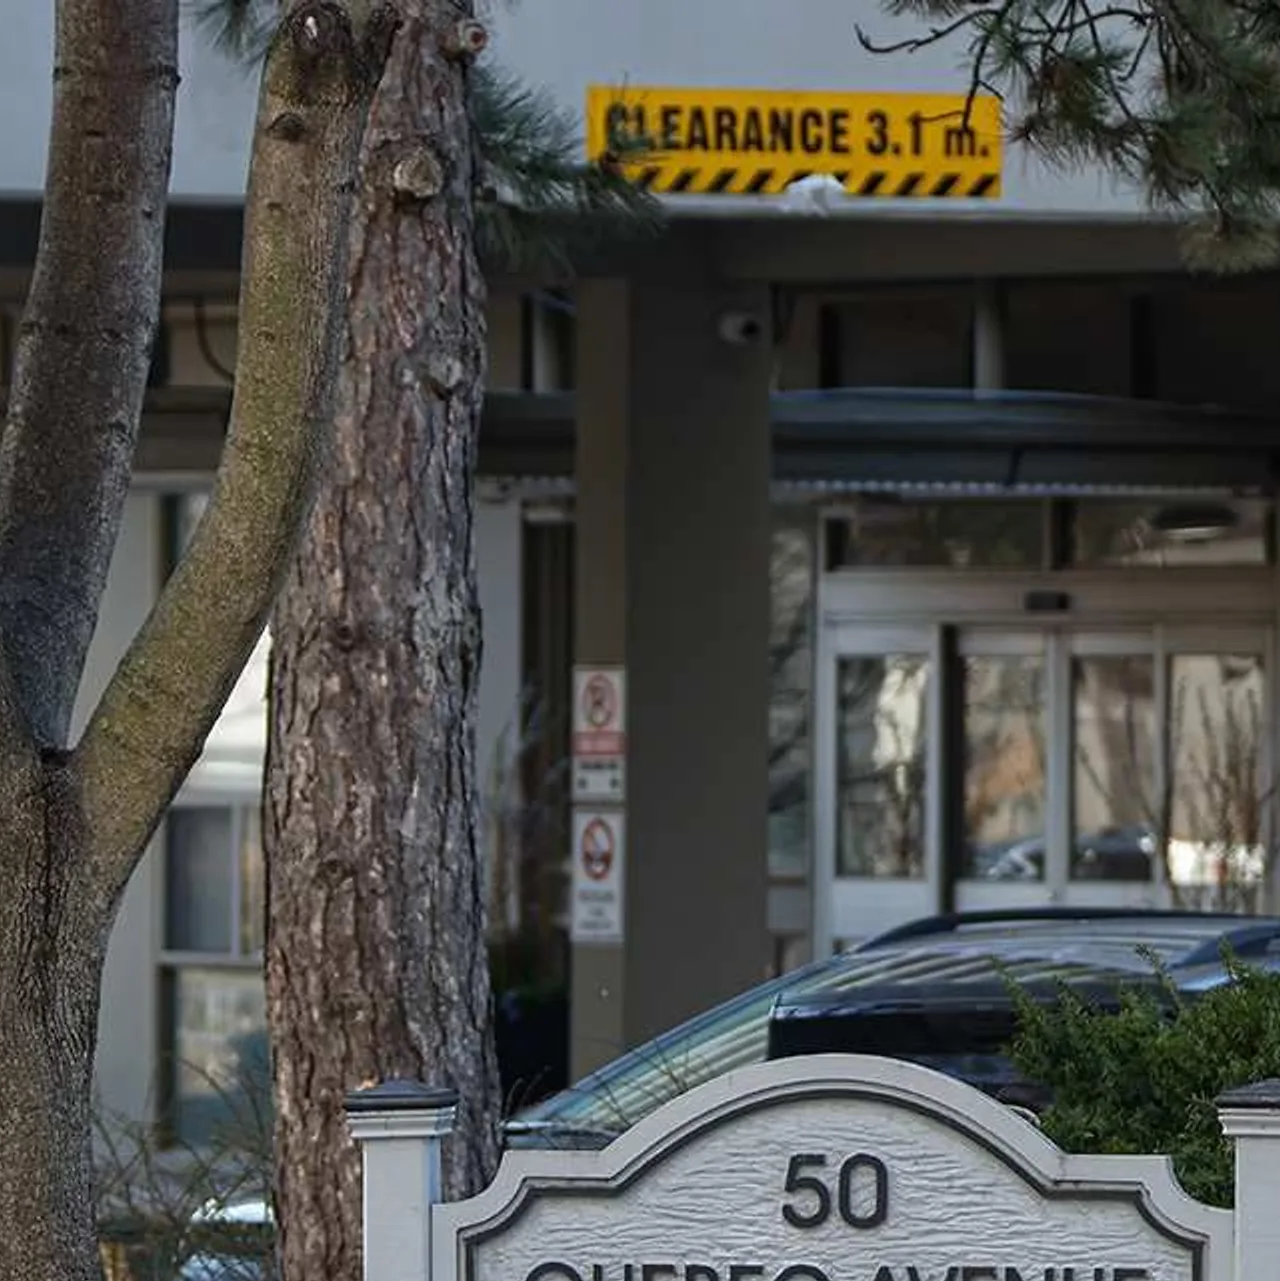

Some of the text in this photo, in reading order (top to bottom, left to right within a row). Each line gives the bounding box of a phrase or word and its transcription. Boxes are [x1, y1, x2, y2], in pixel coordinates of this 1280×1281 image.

[606, 102, 851, 153] CLEARANCE
[866, 108, 925, 155] 3.1
[780, 1153, 890, 1229] 50
